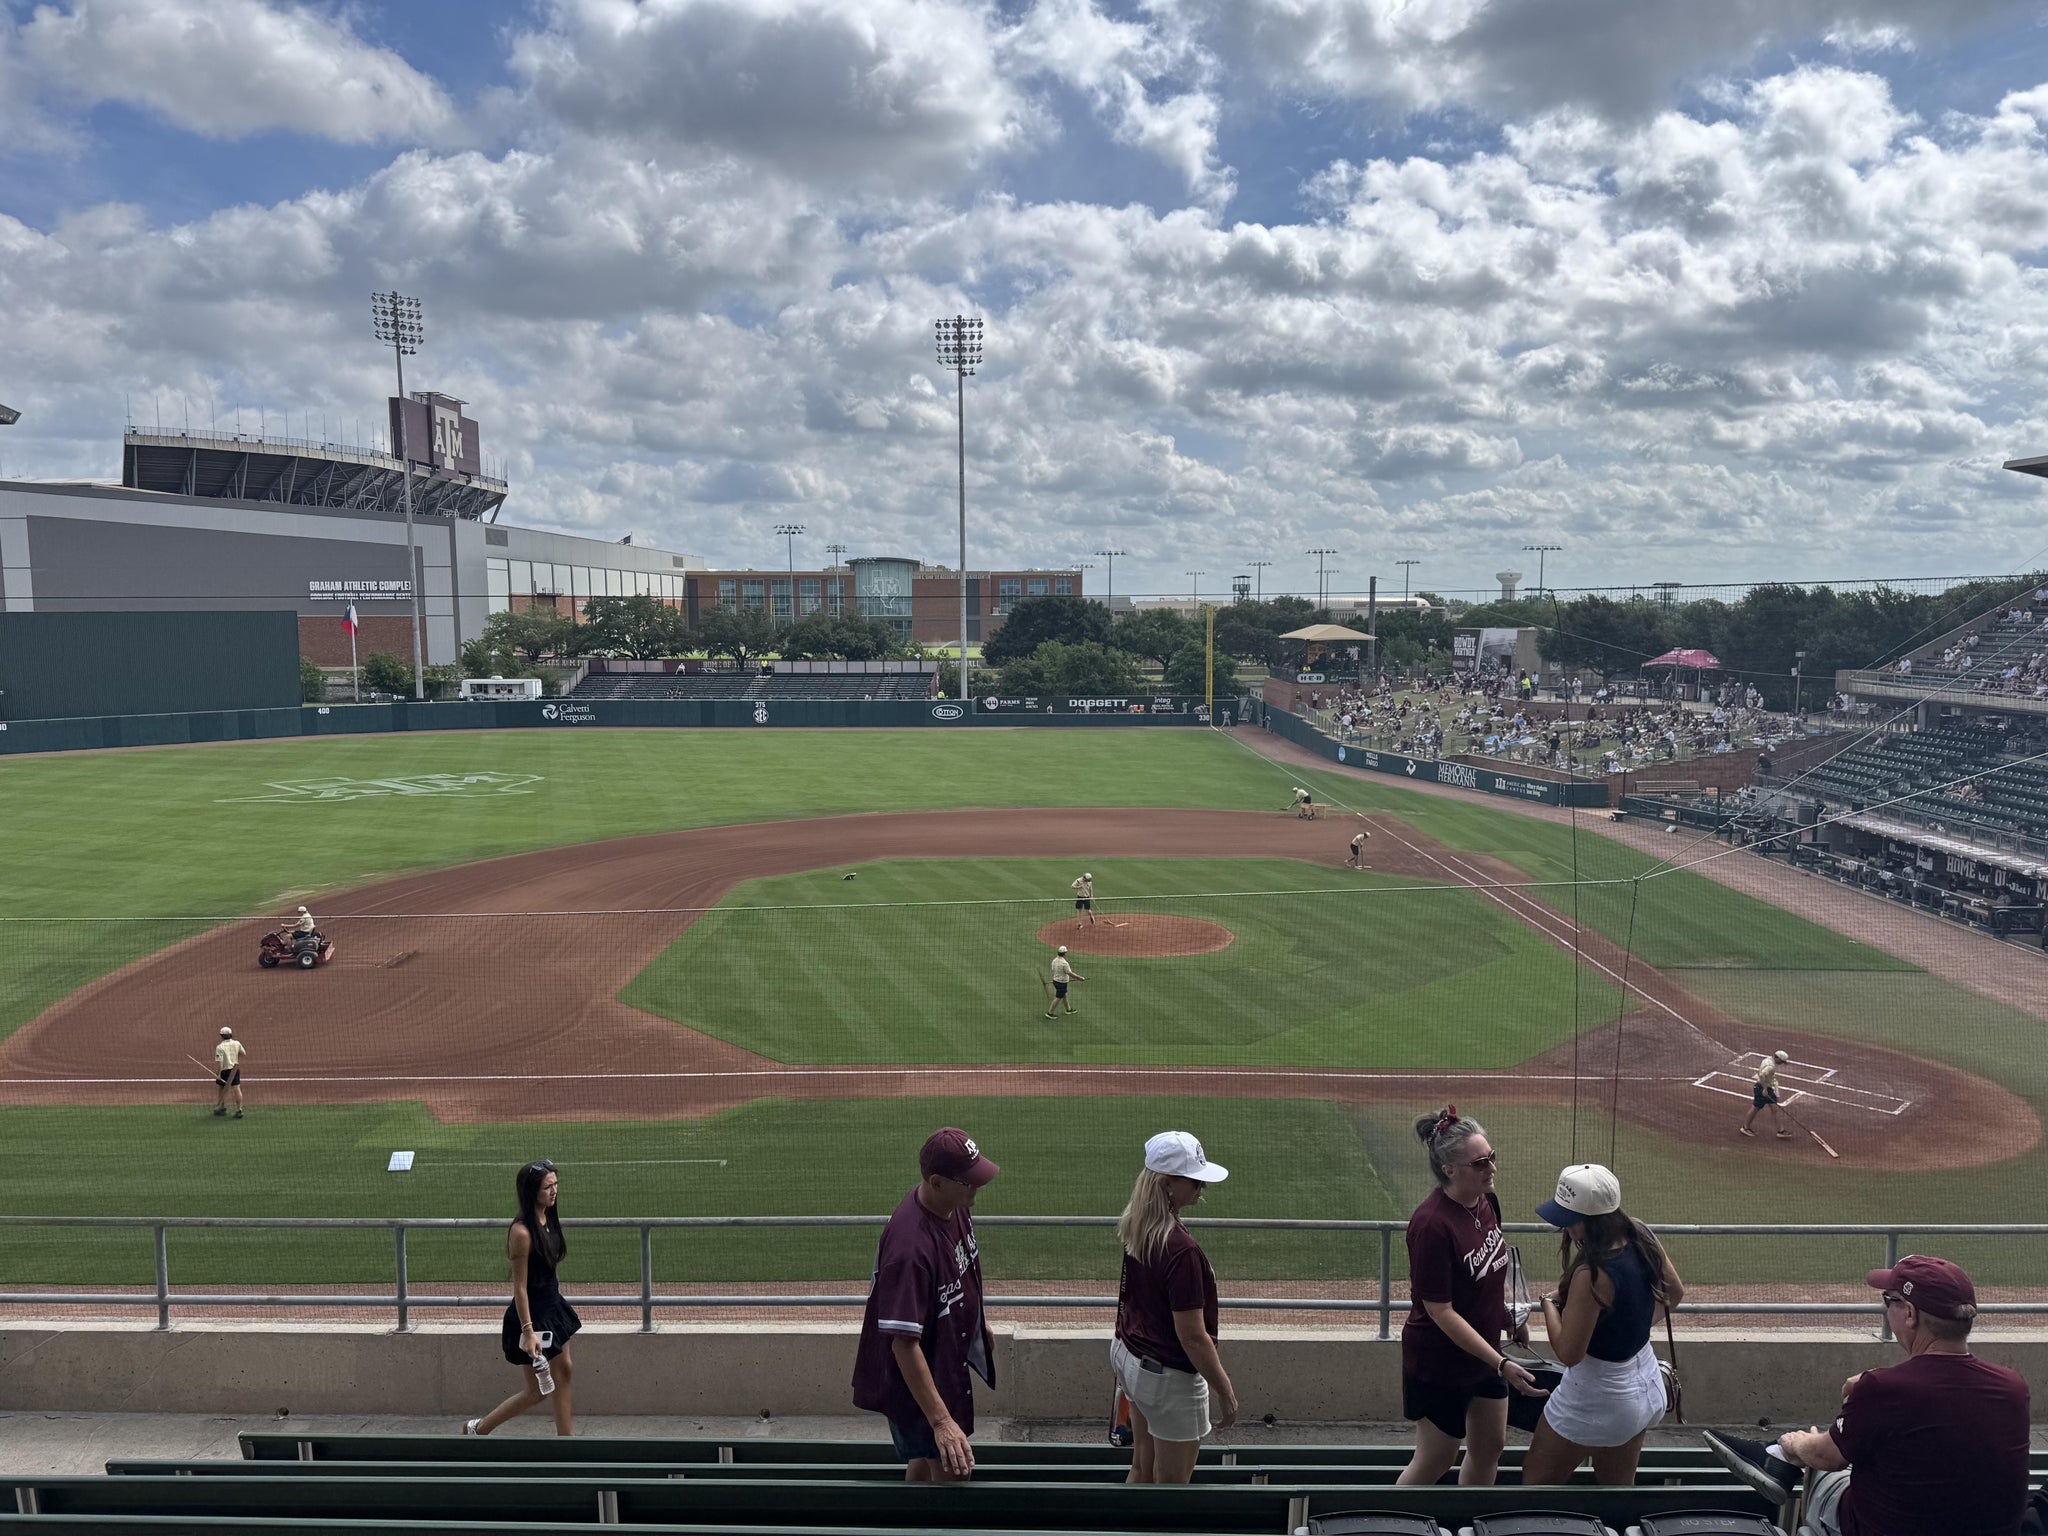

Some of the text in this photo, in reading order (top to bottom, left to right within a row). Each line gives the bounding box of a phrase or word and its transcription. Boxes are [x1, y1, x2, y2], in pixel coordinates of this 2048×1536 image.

[309, 581, 342, 591] GRAHAM
[344, 581, 378, 591] ATHLETIC
[560, 703, 590, 713] Calvetti
[1069, 699, 1128, 707] DOGGETT
[318, 707, 330, 715] 400
[560, 713, 596, 724] Ferguson
[1198, 714, 1210, 722] 330
[1438, 763, 1477, 779] MEMORIAL
[1438, 771, 1476, 788] HERMANN
[1946, 856, 1976, 879] HOME
[2035, 880, 2048, 901] M
[1463, 1242, 1489, 1277] Texas
